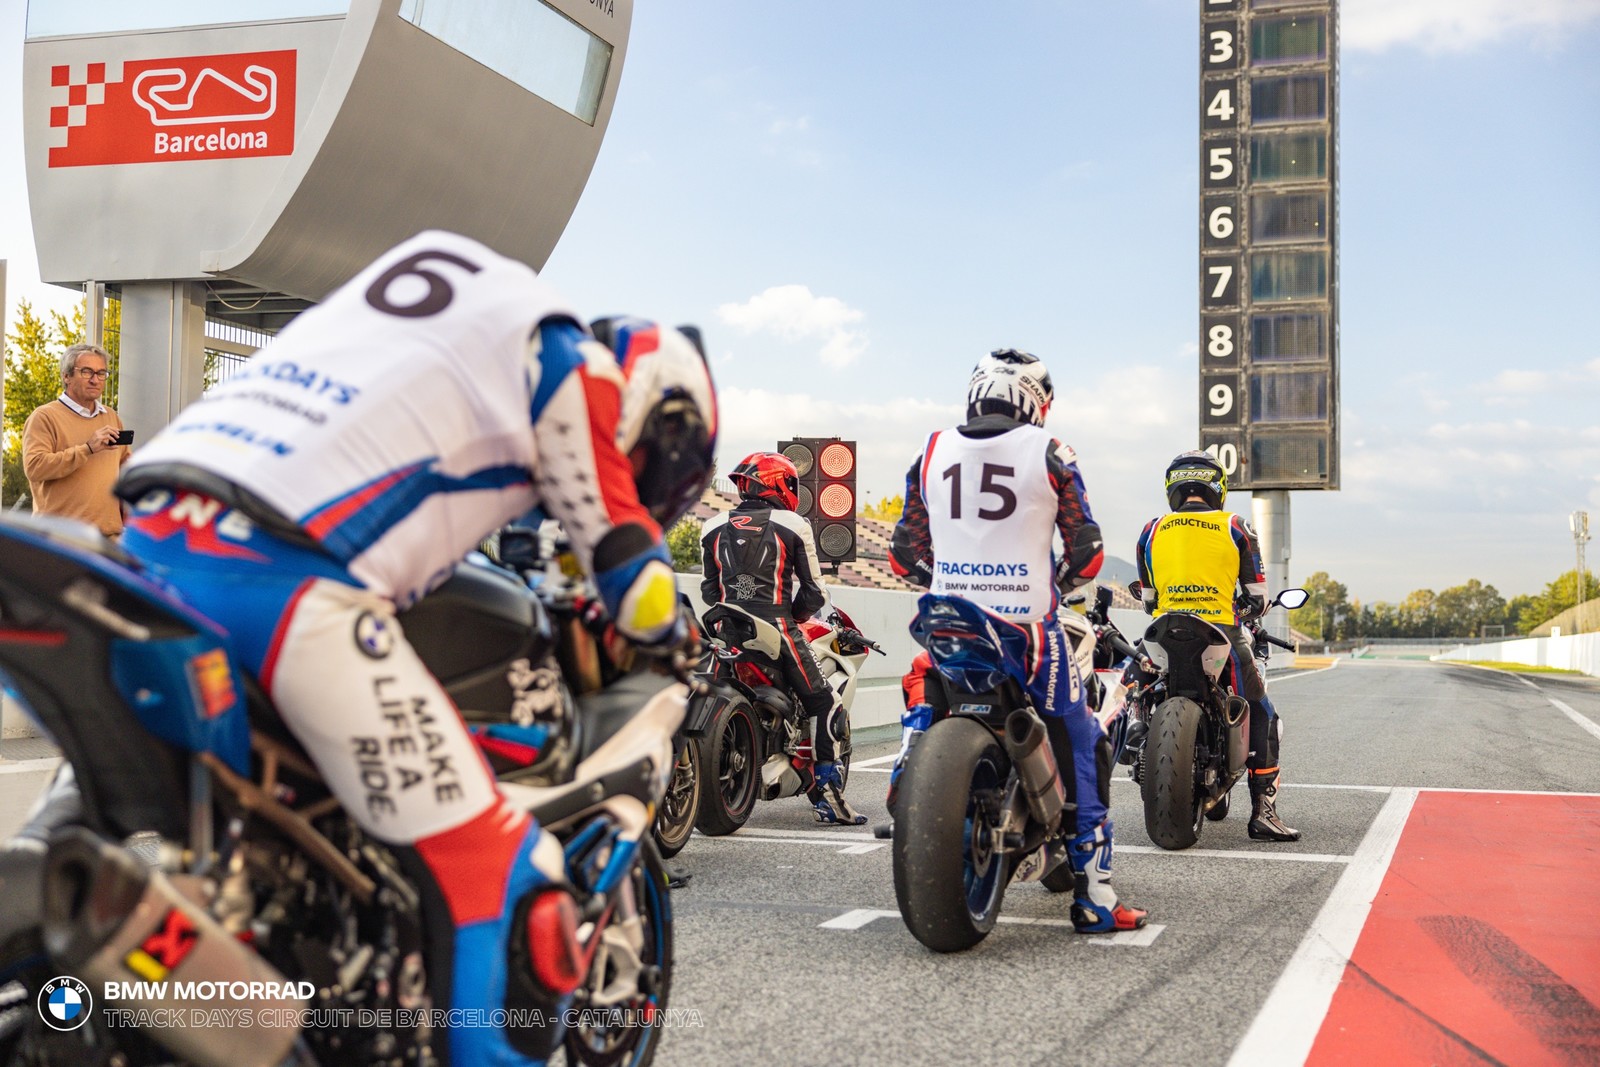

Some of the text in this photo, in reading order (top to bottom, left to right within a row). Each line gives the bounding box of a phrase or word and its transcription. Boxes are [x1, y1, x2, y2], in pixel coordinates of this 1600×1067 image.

[1209, 31, 1233, 63] 3
[1207, 89, 1234, 121] 4
[154, 128, 268, 154] Barcelona
[1209, 148, 1233, 180] 5
[1208, 206, 1234, 239] 6
[365, 251, 482, 318] 6
[1208, 266, 1233, 298] 7
[1208, 325, 1234, 357] 8
[1020, 375, 1046, 405] SHARK
[1208, 384, 1234, 416] 9
[942, 462, 1018, 521] 15
[1160, 518, 1221, 531] INSTRUCTEUR
[937, 561, 1028, 576] TRACKDAYS
[945, 582, 1030, 592] BMW MOTORRAD
[1166, 585, 1219, 595] RACKDAYS
[1045, 630, 1060, 711] BMW Motorrad
[373, 676, 418, 756] LIFE
[396, 767, 423, 791] A
[411, 697, 463, 804] MAKE
[352, 736, 397, 822] RIDE
